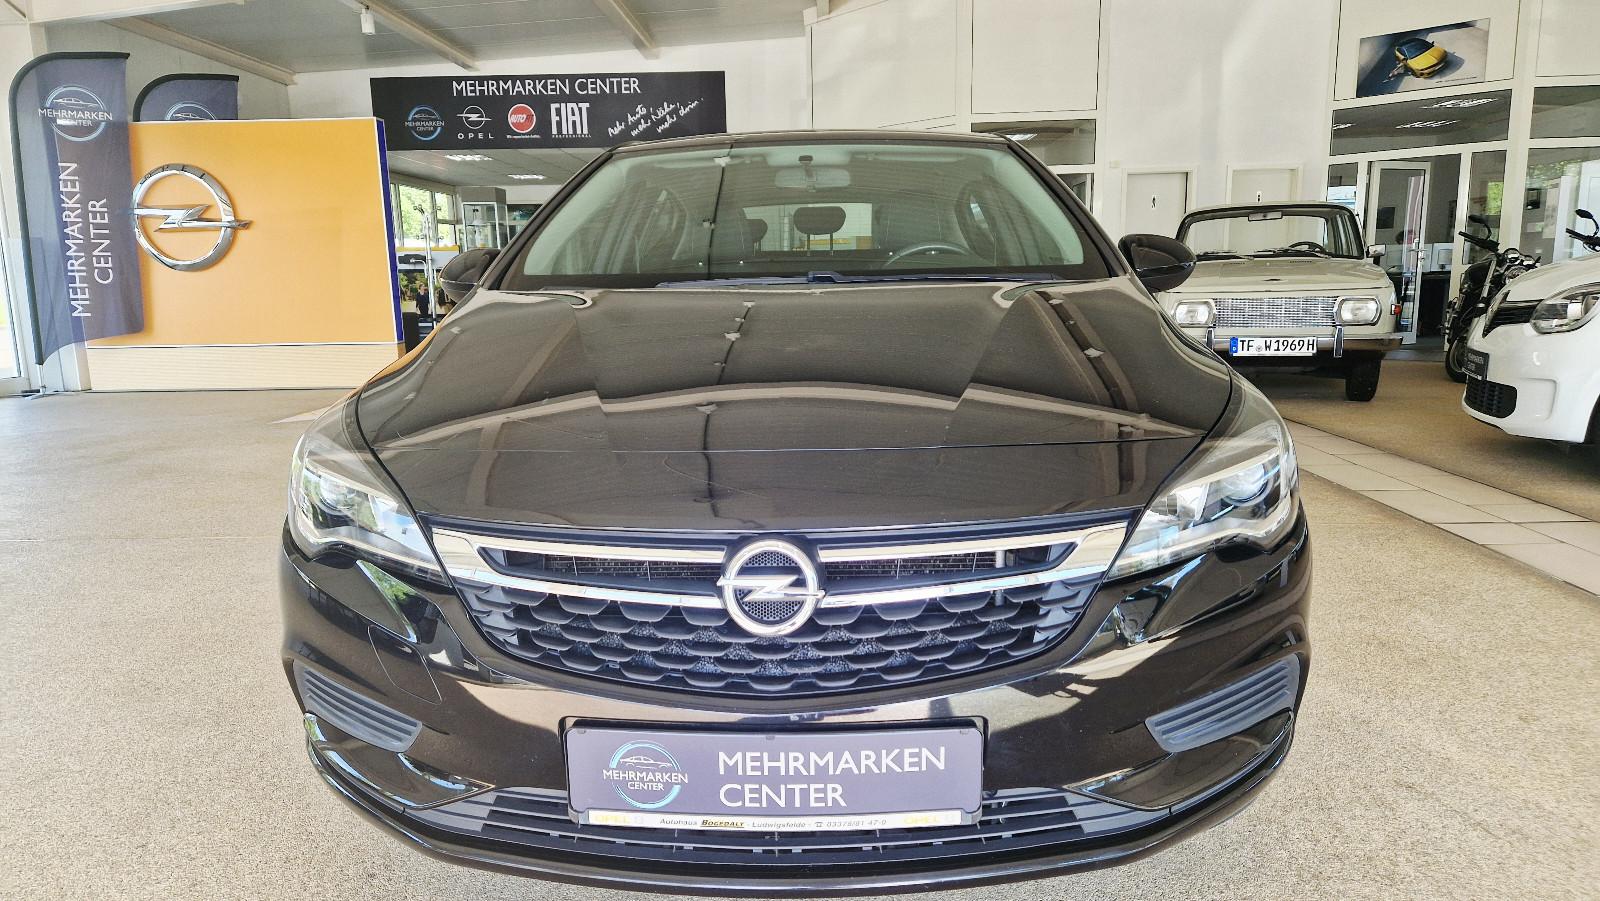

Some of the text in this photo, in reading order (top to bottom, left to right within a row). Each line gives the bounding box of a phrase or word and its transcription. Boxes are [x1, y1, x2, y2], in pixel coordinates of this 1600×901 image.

[452, 77, 642, 96] MEHRMARKEN CENTER
[38, 108, 113, 121] MEHRMARKEN
[550, 102, 590, 135] FIAT
[457, 132, 494, 140] OPEL
[57, 162, 92, 317] MEHRMARKEN
[88, 198, 114, 285] CENTER
[1239, 339, 1254, 352] TF
[718, 746, 945, 776] MEHRMARKEN
[602, 768, 689, 784] MEHRMARKEN
[627, 781, 665, 792] CENTER
[719, 783, 847, 808] CENTER
[659, 818, 698, 826] Autohaus
